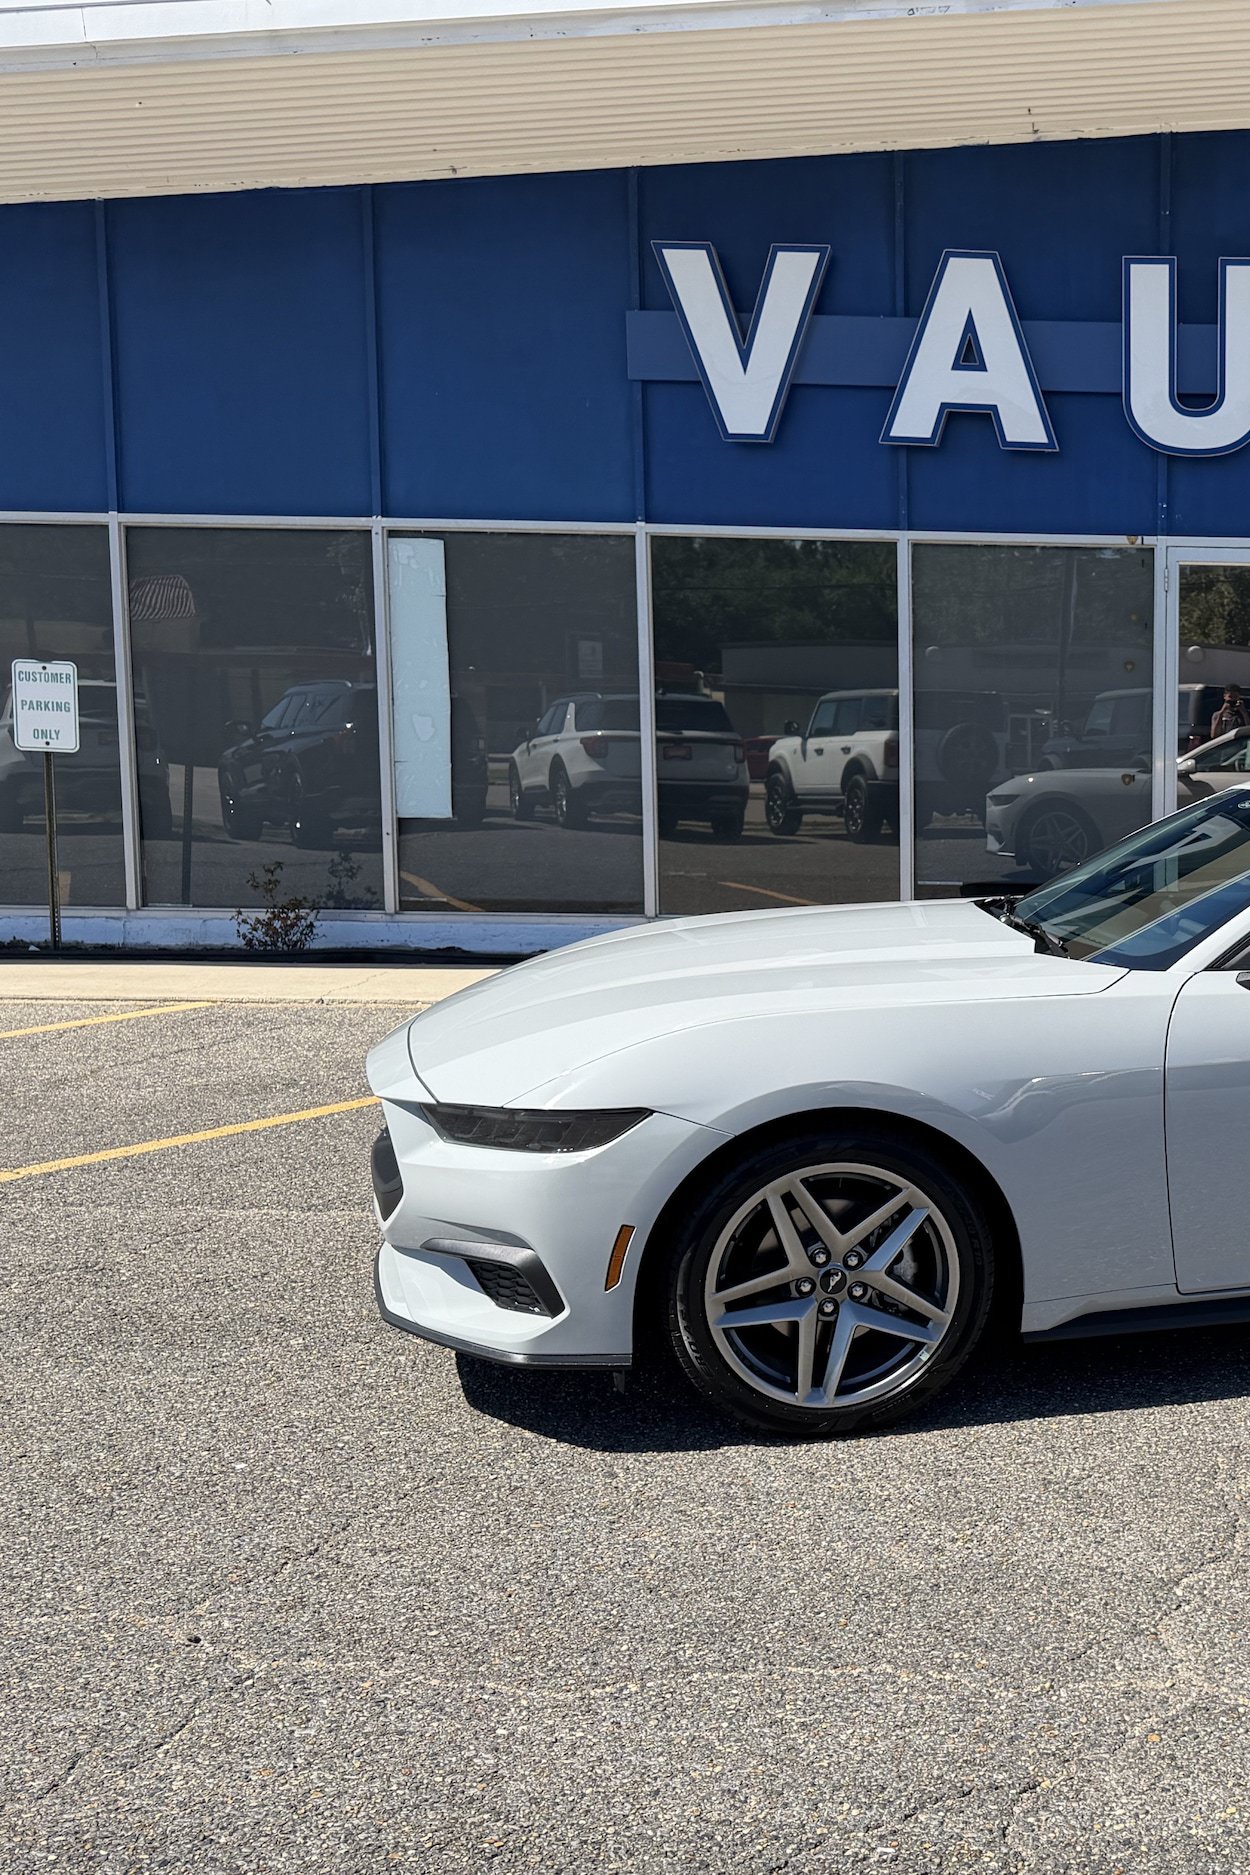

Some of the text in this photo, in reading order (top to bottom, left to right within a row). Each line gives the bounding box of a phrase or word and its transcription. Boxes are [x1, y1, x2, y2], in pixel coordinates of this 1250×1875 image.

[18, 670, 72, 684] CUSTOMER
[20, 699, 71, 713] PARKING
[32, 728, 61, 741] ONLY
